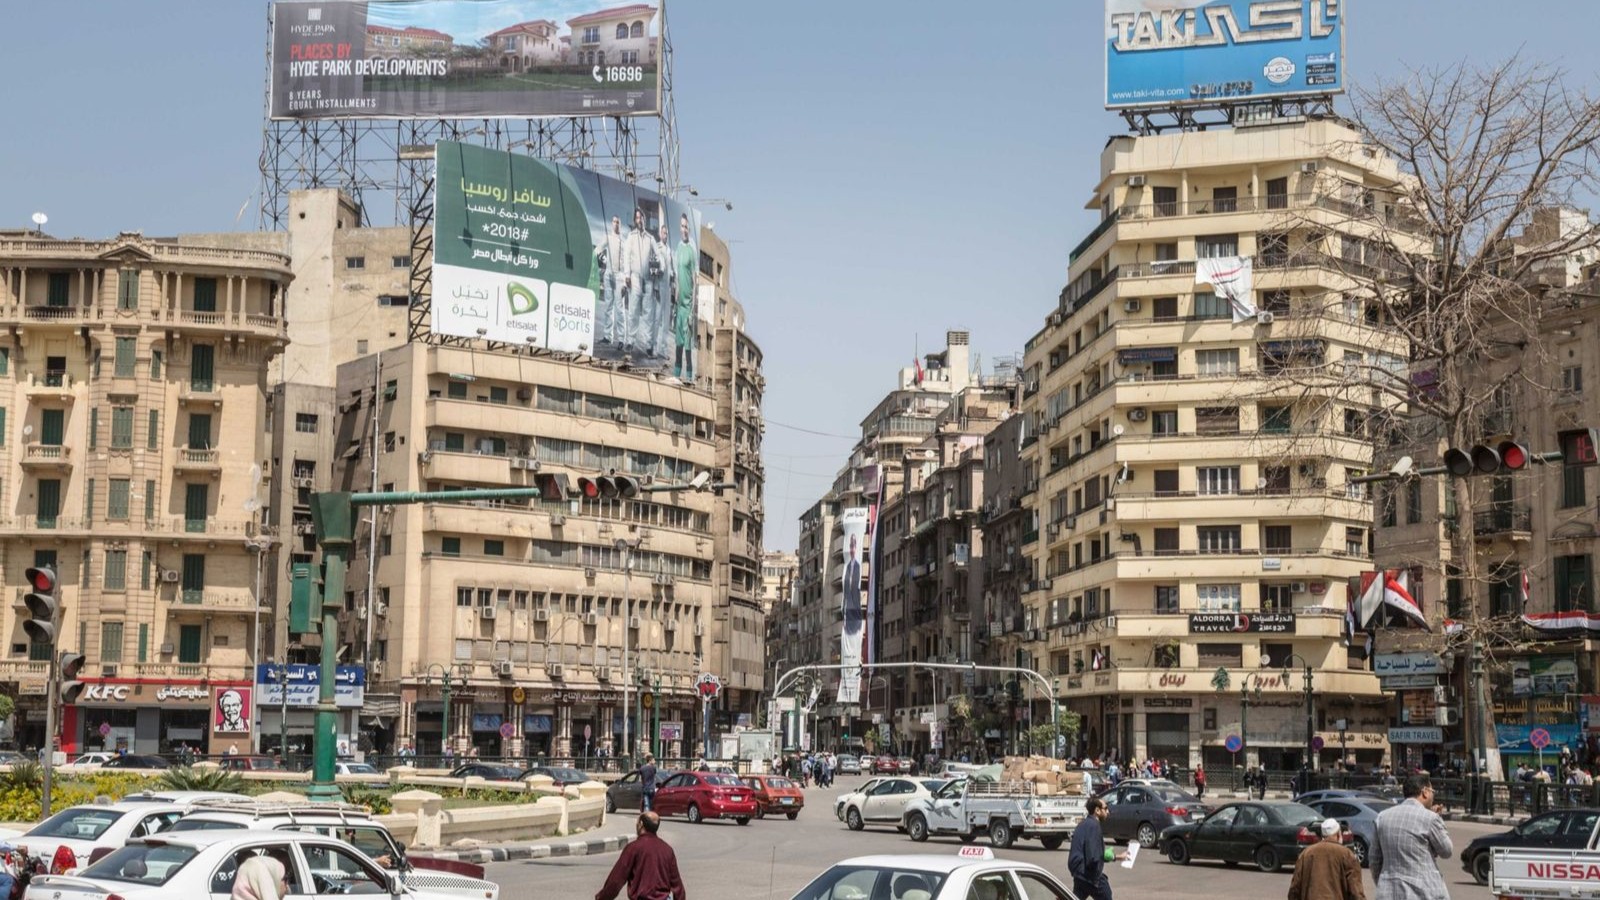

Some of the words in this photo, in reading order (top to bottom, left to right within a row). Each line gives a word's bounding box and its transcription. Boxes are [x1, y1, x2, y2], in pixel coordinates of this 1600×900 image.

[291, 25, 313, 33] HYDE
[315, 24, 336, 32] PARK
[290, 43, 333, 60] PLACES
[337, 42, 352, 58] BY
[290, 61, 319, 77] HYDE
[322, 60, 352, 76] PARK
[355, 59, 447, 76] DEVELOPMENTS
[606, 66, 642, 81] 16696
[289, 91, 294, 100] 8
[297, 90, 322, 100] YEARS
[1112, 88, 1184, 99] www.taki-vita.com
[289, 101, 313, 110] EQUAL
[316, 98, 377, 109] INSTALLMENTS
[461, 177, 507, 202] روسيا
[513, 188, 551, 207] سافر
[471, 248, 490, 259] مصر
[513, 254, 528, 266] كل
[554, 304, 591, 319] etisalat
[506, 319, 537, 332] etisalat
[1377, 658, 1410, 672] للسياحة
[1413, 656, 1437, 671] سفير
[84, 685, 130, 700] KFC
[1390, 731, 1411, 739] SAFIR
[1413, 731, 1440, 740] TRAVEL
